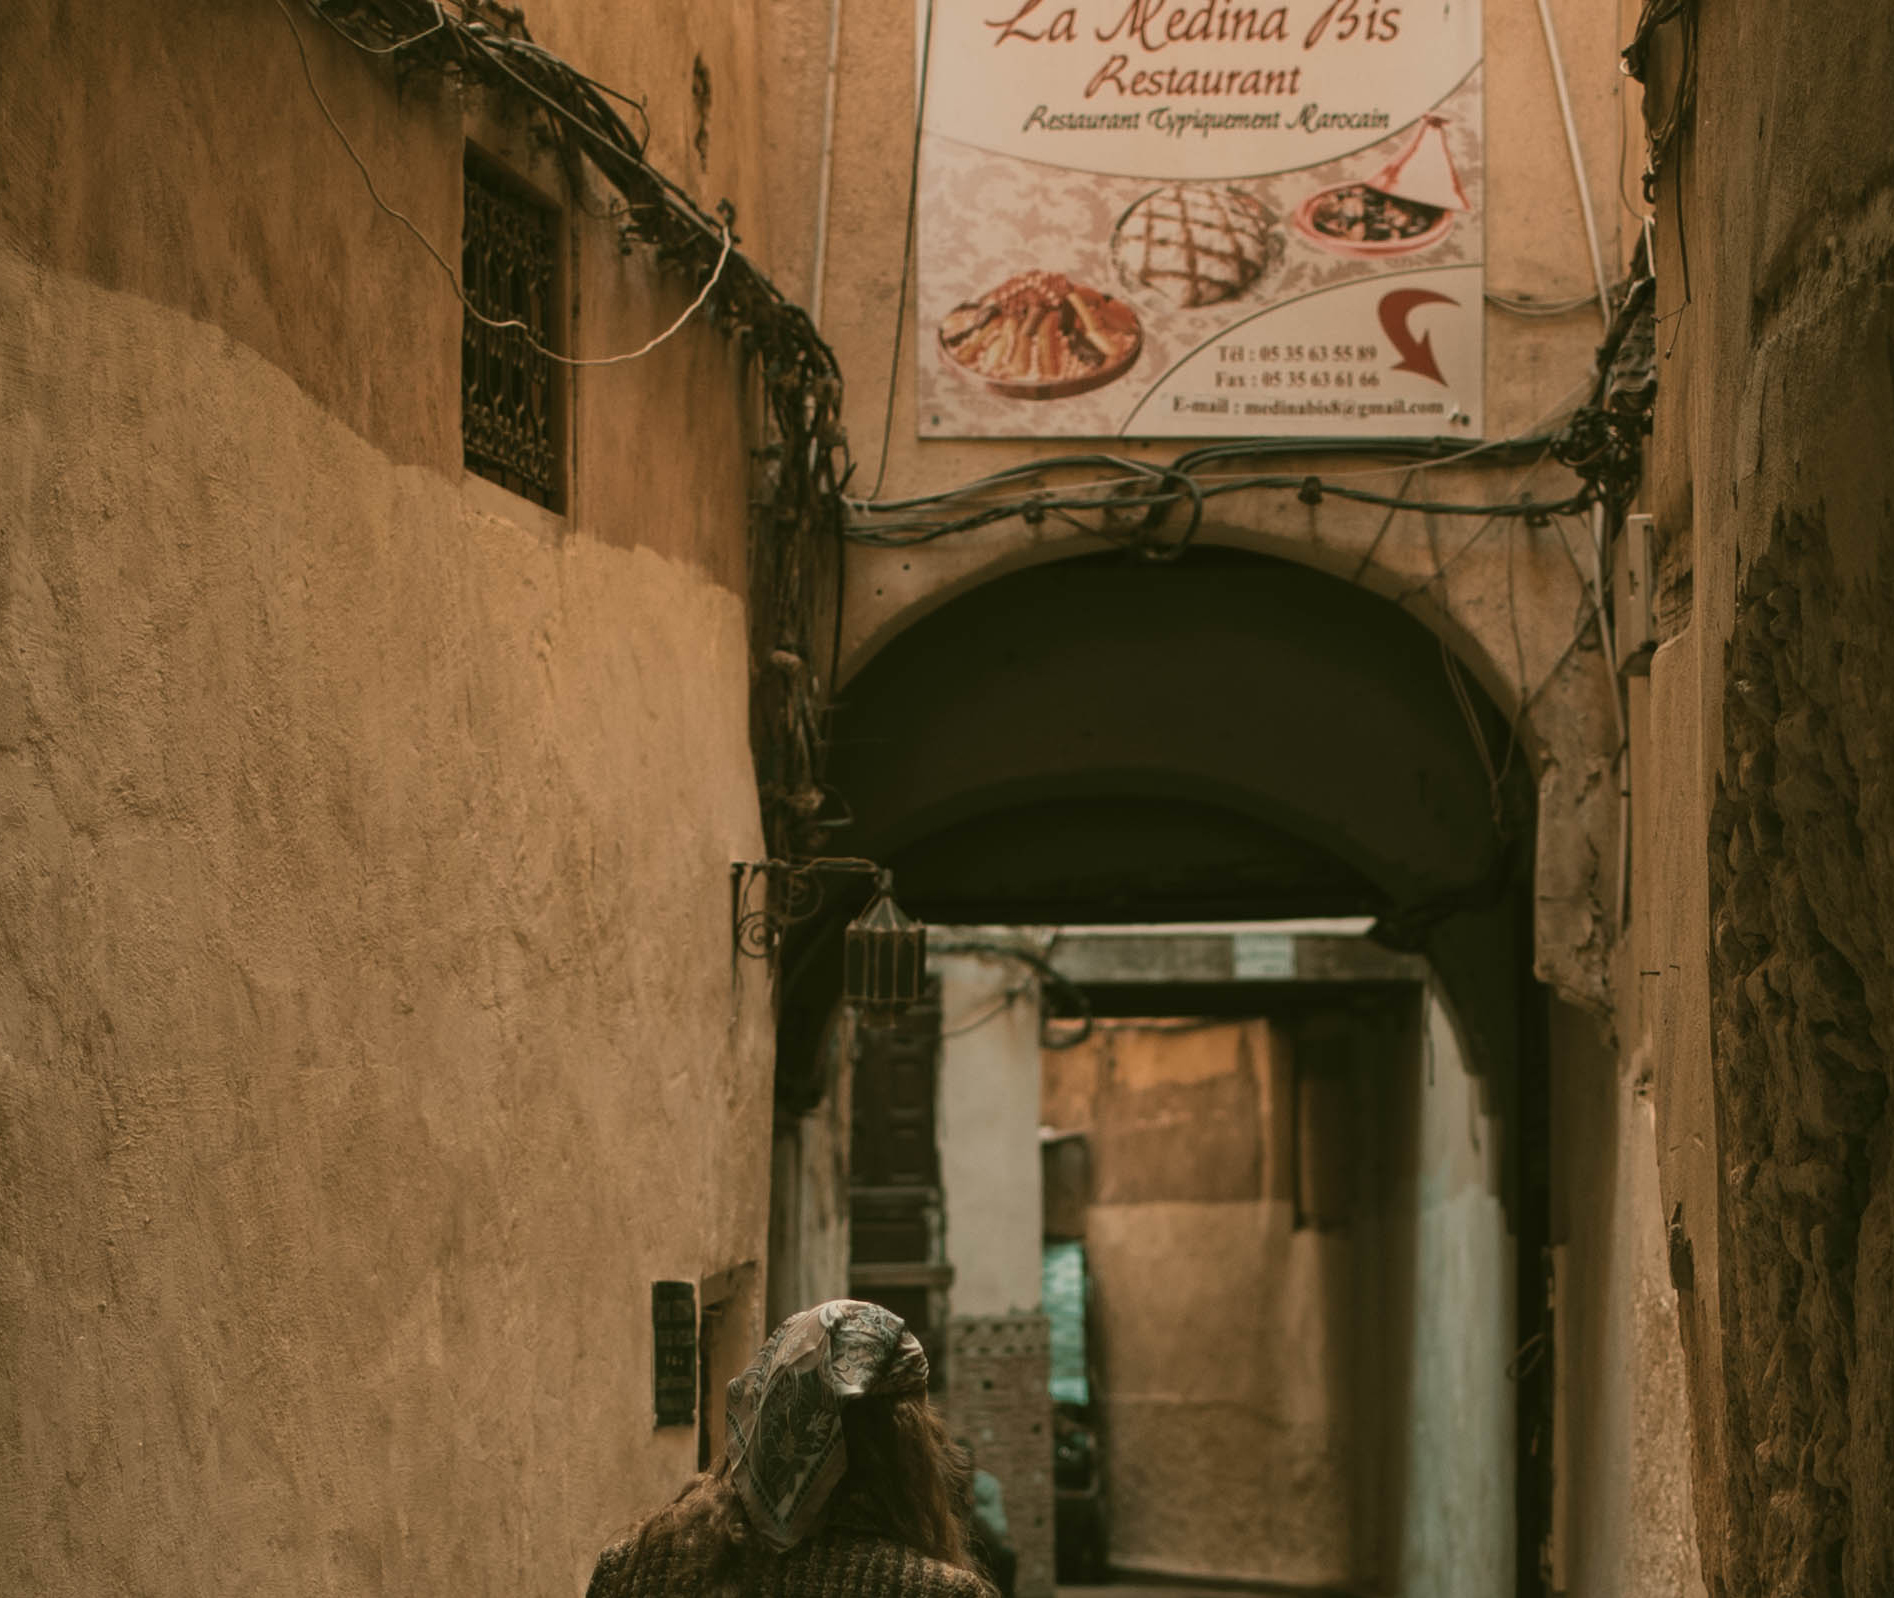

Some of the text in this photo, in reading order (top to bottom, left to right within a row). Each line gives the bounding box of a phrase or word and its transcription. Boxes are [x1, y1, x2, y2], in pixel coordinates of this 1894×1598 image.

[983, 0, 1401, 52] La Medina Bis
[1083, 54, 1301, 99] Restaurant
[1021, 102, 1390, 138] Restaurant Typiquement Marocain
[1259, 345, 1280, 362] 05
[1284, 345, 1304, 362] 35
[1308, 345, 1327, 361] 63
[1331, 345, 1352, 362] 55
[1215, 371, 1245, 388] Fax
[1261, 371, 1282, 387] 05
[1287, 371, 1307, 387] 35
[1310, 371, 1330, 387] 63
[1334, 371, 1352, 387] 61
[1359, 372, 1380, 387] 66
[1173, 395, 1229, 414] E-mail
